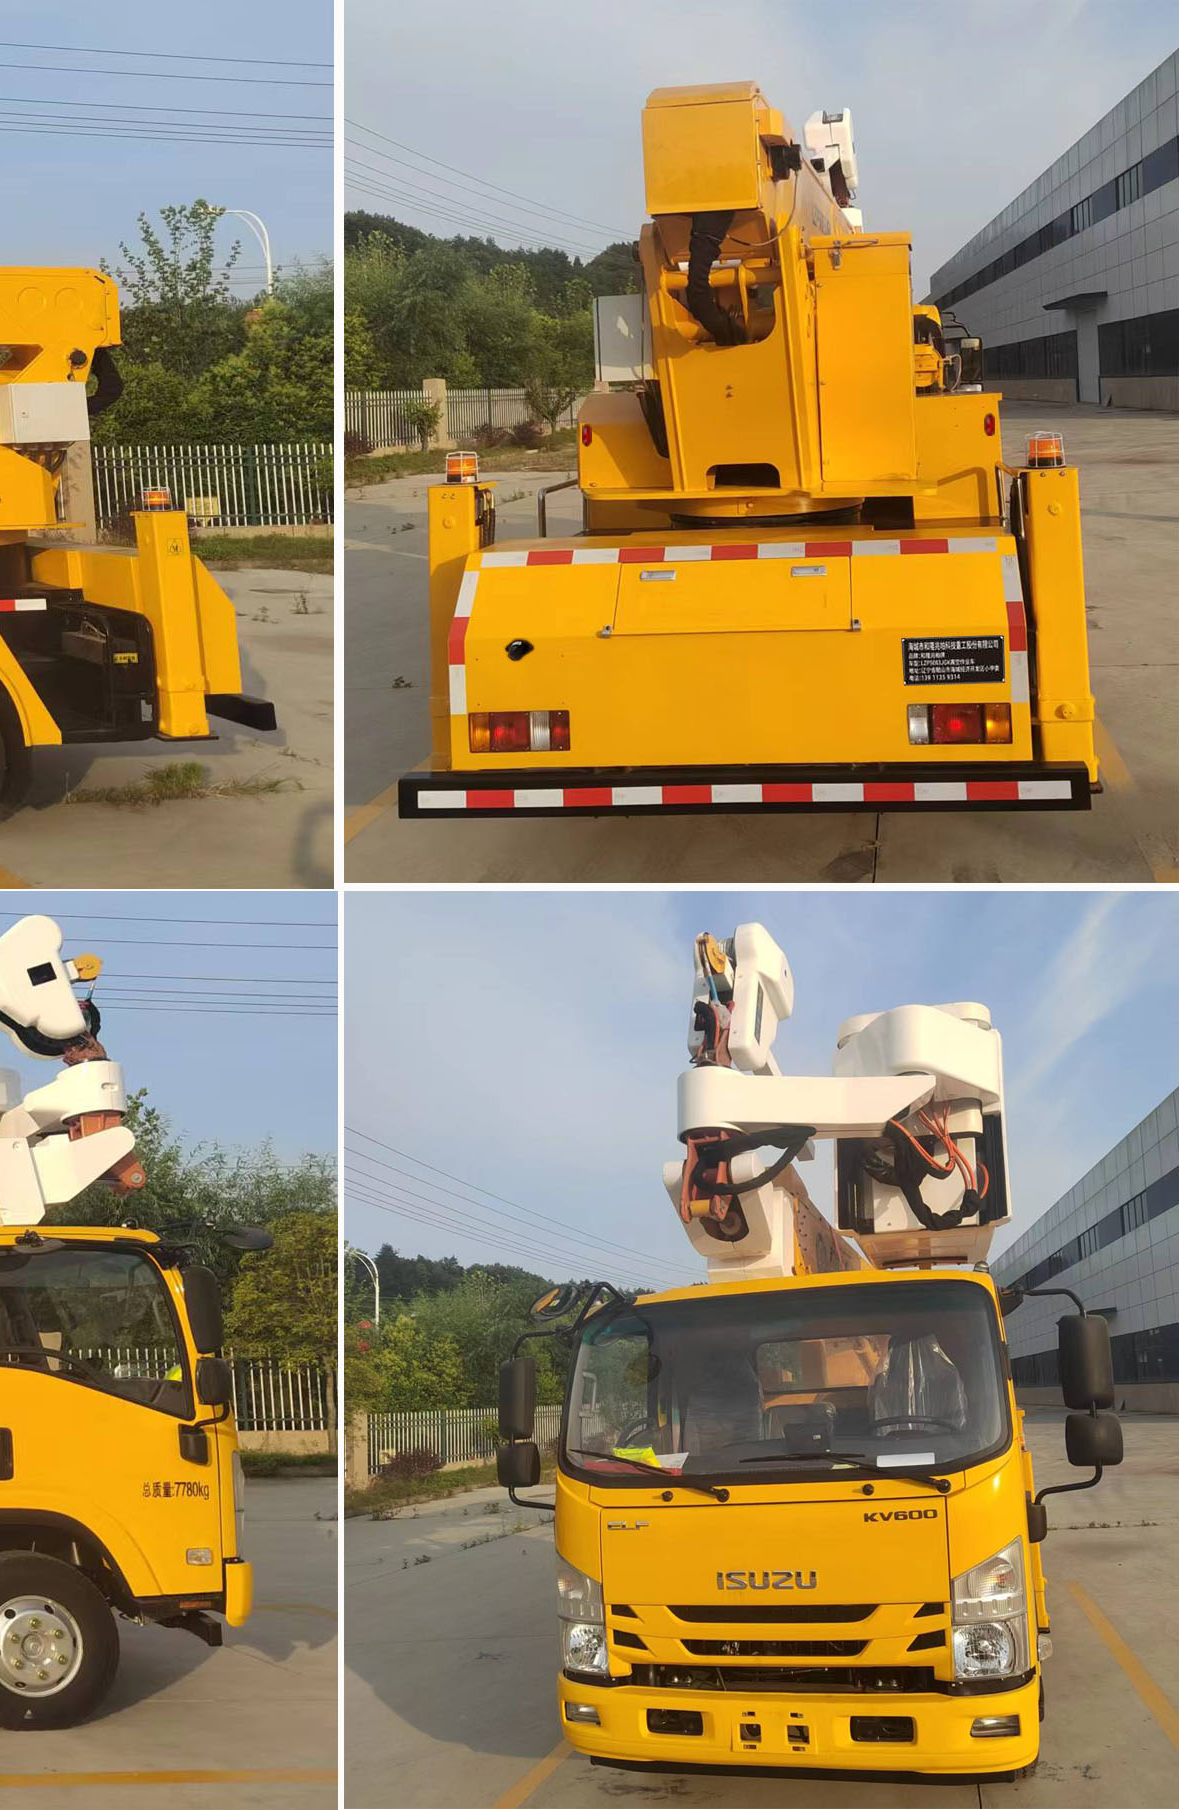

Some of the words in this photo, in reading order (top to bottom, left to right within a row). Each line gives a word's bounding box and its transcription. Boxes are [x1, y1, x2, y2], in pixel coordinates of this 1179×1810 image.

[142, 1481, 210, 1501] 总质量:7780kg
[863, 1509, 938, 1523] KV600
[716, 1570, 817, 1591] ISUZU
